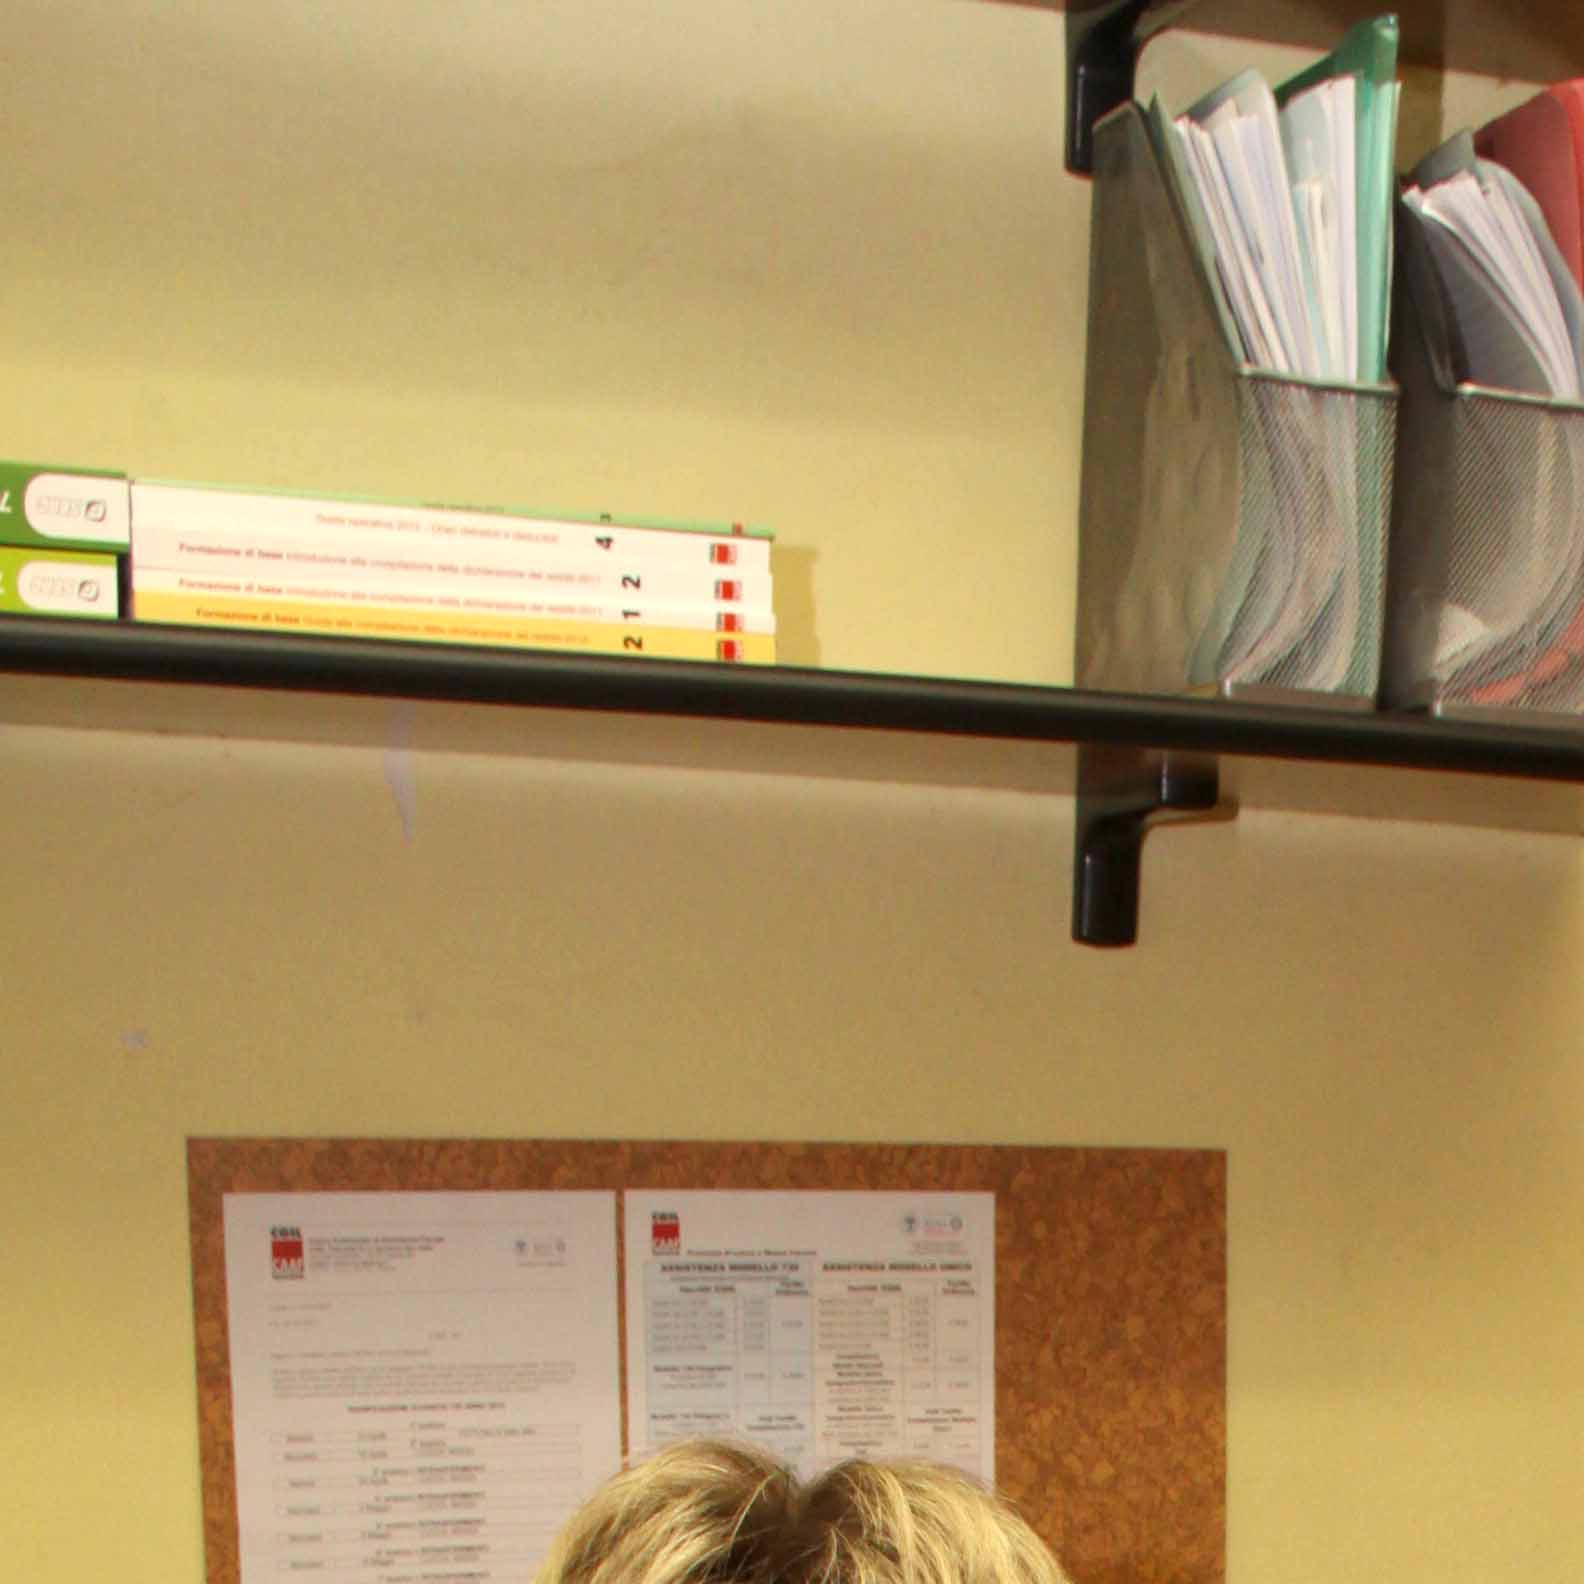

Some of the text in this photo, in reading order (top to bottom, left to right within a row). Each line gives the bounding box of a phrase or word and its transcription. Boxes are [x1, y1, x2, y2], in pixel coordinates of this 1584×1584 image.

[595, 535, 613, 550] 4
[622, 575, 641, 589] 2
[622, 609, 641, 619] 1
[624, 635, 643, 650] 2
